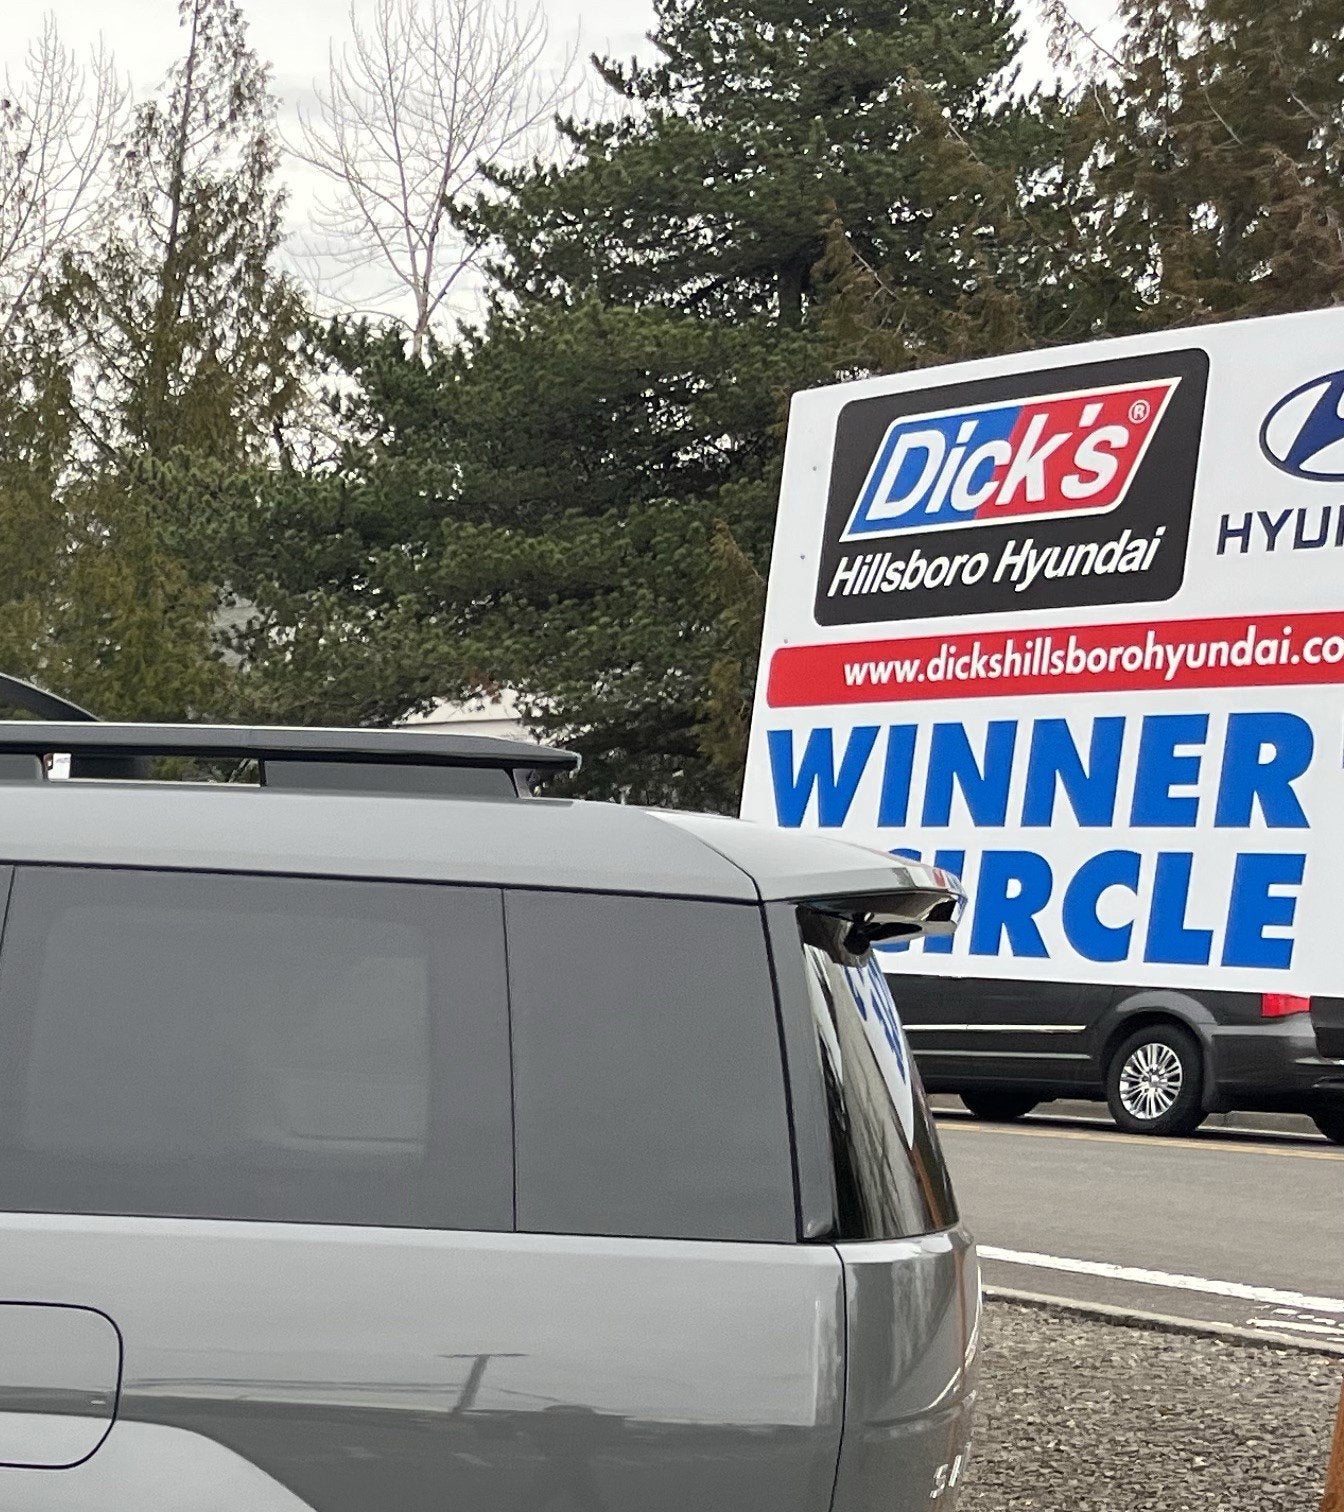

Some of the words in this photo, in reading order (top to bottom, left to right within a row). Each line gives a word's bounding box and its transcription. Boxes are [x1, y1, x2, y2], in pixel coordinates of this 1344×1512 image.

[826, 549, 989, 598] Hillsboro
[992, 526, 1167, 593] Hyundai
[1216, 504, 1344, 556] HYU
[766, 711, 1314, 828] WINNER
[868, 848, 1308, 971] RCLE
